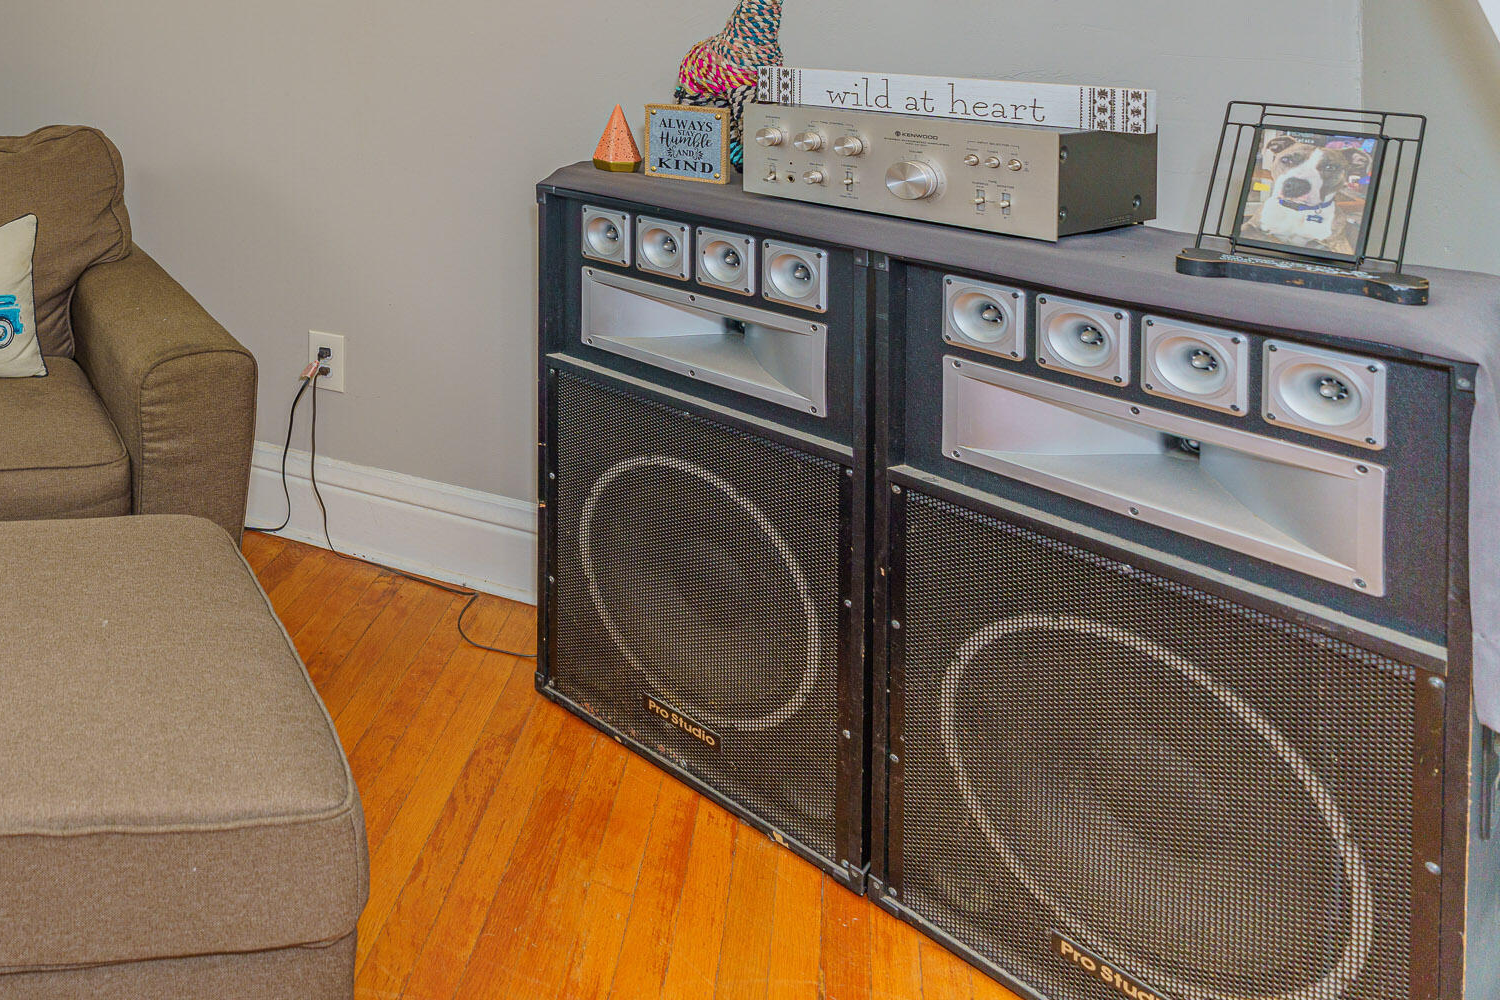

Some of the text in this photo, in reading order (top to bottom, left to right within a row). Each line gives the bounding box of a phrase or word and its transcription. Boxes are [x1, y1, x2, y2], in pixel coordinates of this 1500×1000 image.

[826, 77, 1045, 122] wild at heart
[659, 118, 713, 132] ALWAYS
[660, 131, 713, 148] Humble
[901, 132, 939, 141] KENWOOD
[676, 149, 694, 157] AND
[658, 157, 713, 174] KIND
[648, 700, 715, 746] Pro Studio
[1060, 940, 1096, 971] Pro
